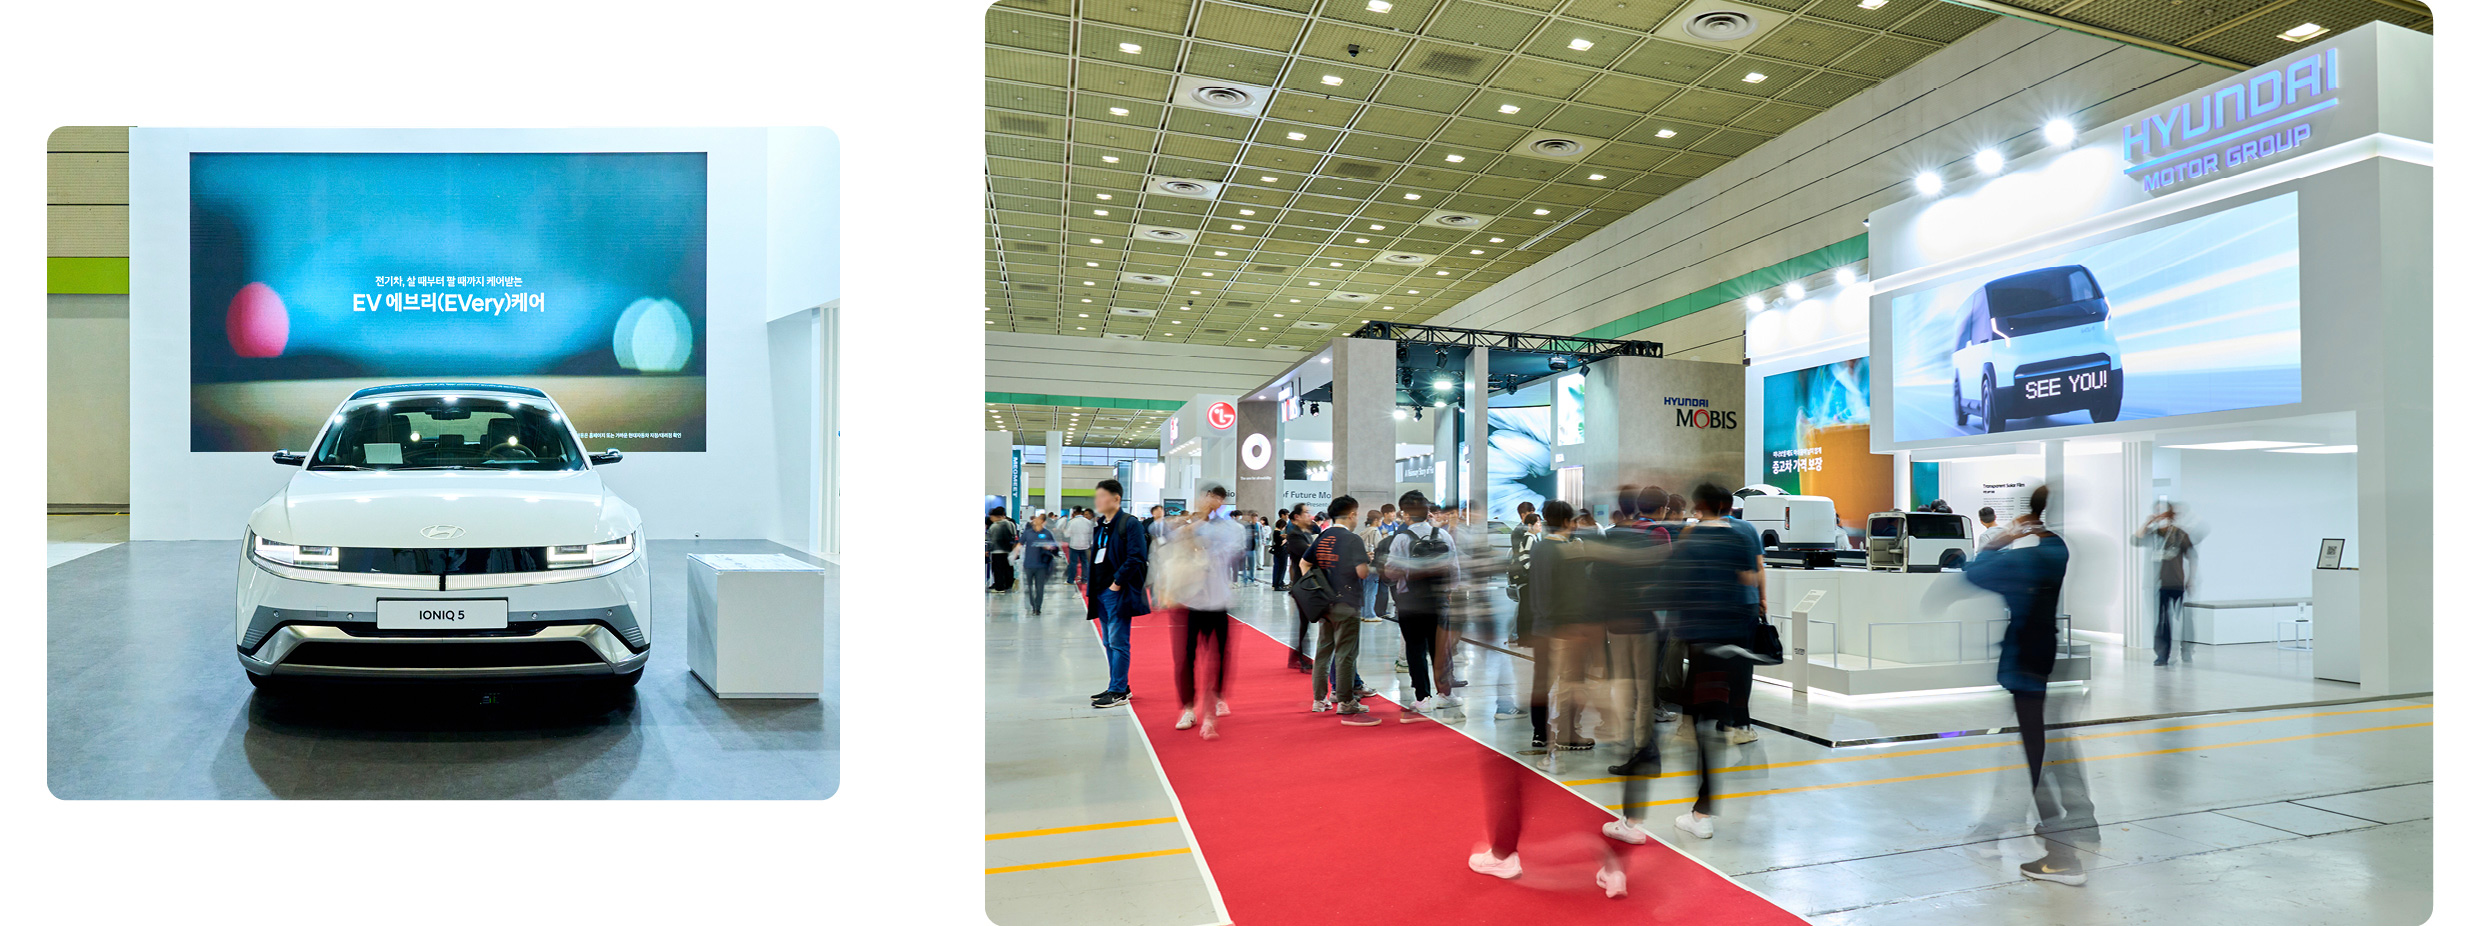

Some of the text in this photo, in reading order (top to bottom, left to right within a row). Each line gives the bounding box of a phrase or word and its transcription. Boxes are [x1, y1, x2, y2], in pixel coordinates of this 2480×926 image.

[2122, 48, 2338, 161] HYUNDAI
[2143, 123, 2311, 192] MOTOR GROUP
[375, 276, 523, 287] 전기차, 살 때부터 팔 때까지 케어받는
[353, 292, 545, 316] EV 에브리(EVery)케어
[2025, 370, 2107, 399] SEE YOU!
[1664, 397, 1709, 407] HYUNDAI
[1676, 408, 1737, 429] MOBIS
[1772, 457, 1823, 475] 중고차 가격 보장
[1291, 491, 1317, 499] Future
[419, 610, 465, 622] IONIQ 5
